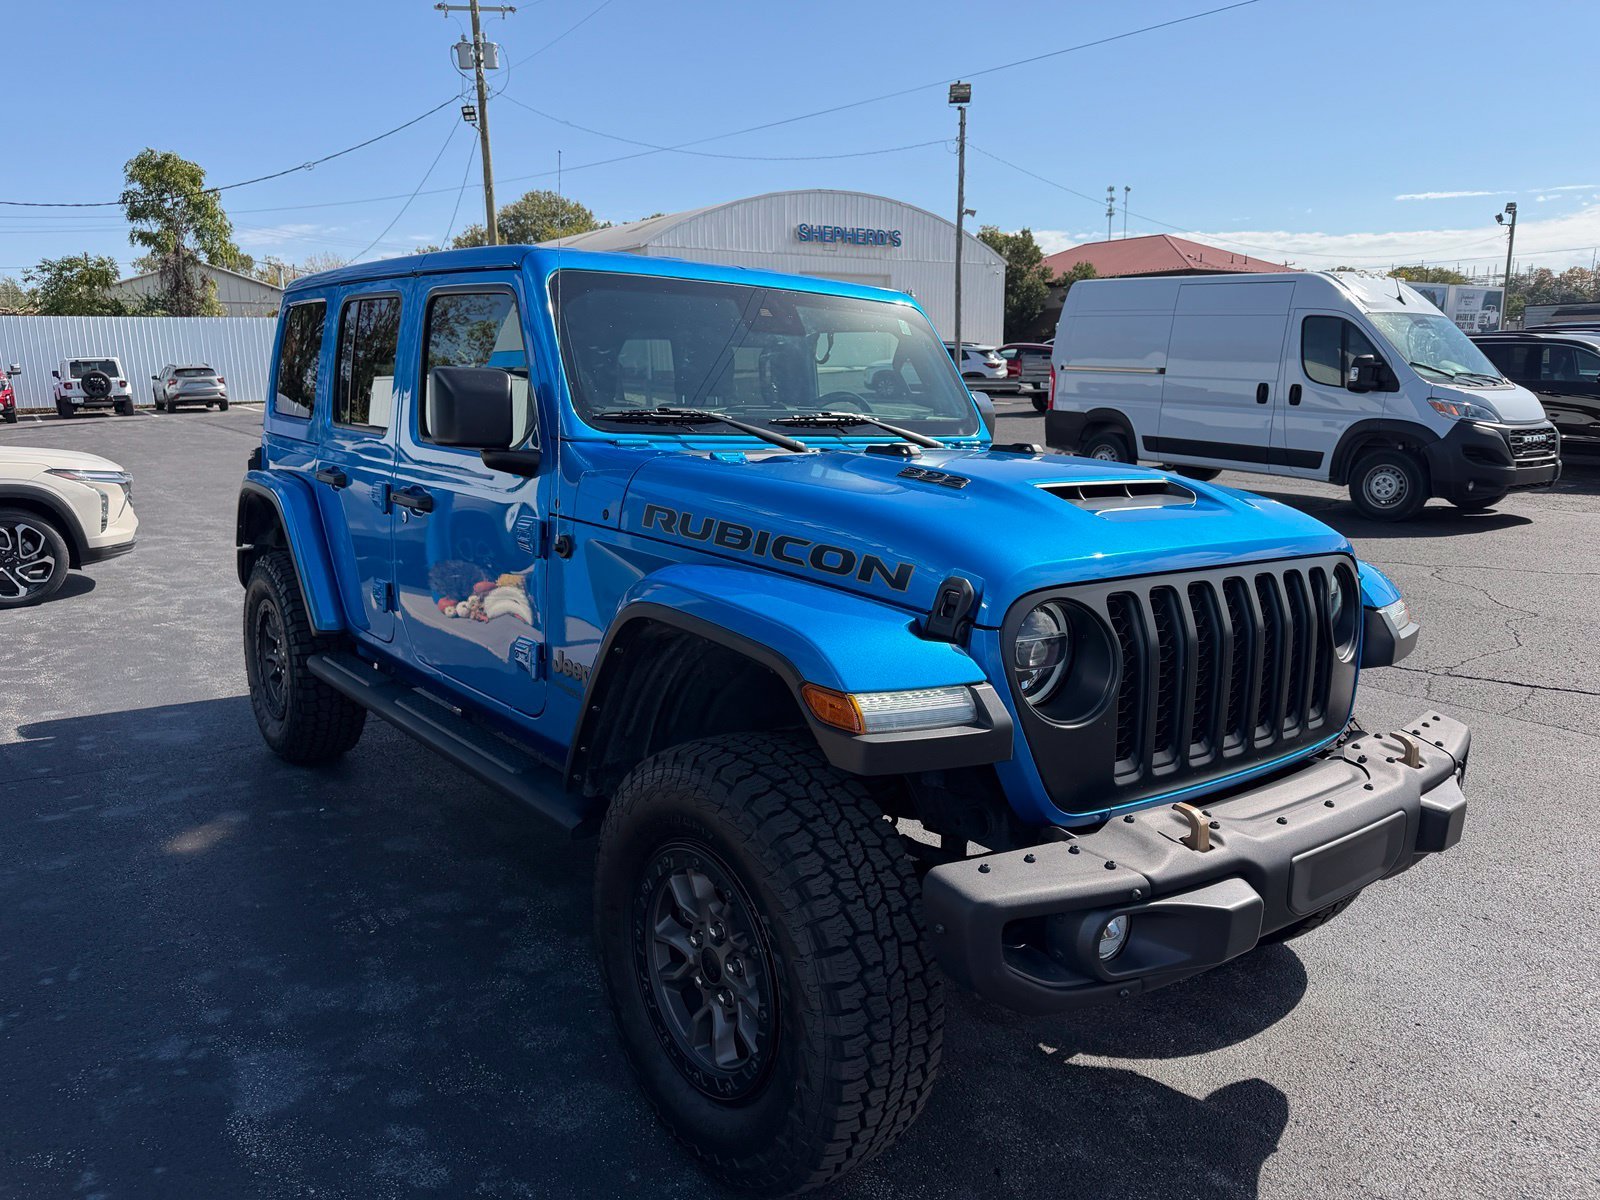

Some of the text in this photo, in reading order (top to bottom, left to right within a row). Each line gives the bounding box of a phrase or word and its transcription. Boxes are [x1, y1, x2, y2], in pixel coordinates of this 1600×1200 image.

[797, 223, 901, 247] SHEPHERD'S
[1524, 434, 1547, 443] RAM
[642, 503, 915, 592] RUBICON
[552, 649, 592, 688] Jeep
